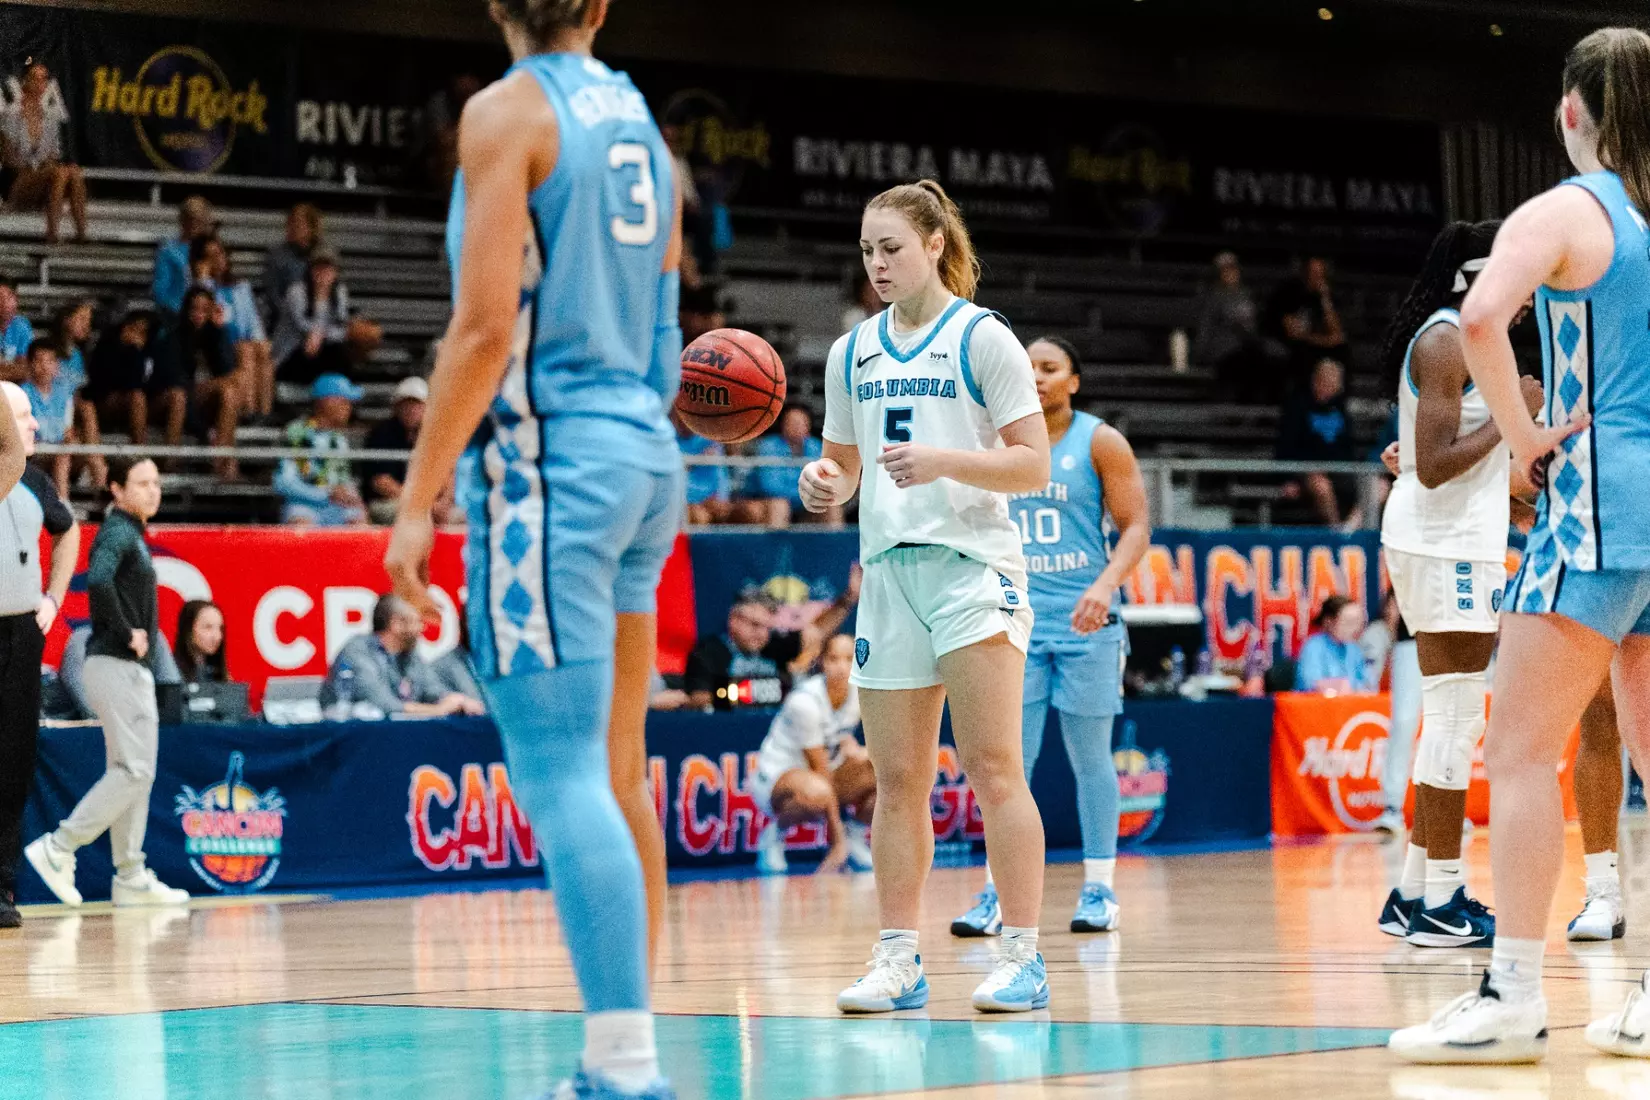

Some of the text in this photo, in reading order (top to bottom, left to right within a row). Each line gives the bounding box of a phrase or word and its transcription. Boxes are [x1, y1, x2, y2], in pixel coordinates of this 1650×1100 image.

[91, 65, 182, 119] Hard
[184, 72, 268, 135] Rock
[792, 134, 1054, 195] RIVIERA MAYA
[607, 141, 658, 244] 3
[1212, 166, 1338, 213] RIVIERA
[857, 378, 956, 402] COLUMBIA
[884, 406, 914, 443] 5
[1018, 507, 1061, 544] 10
